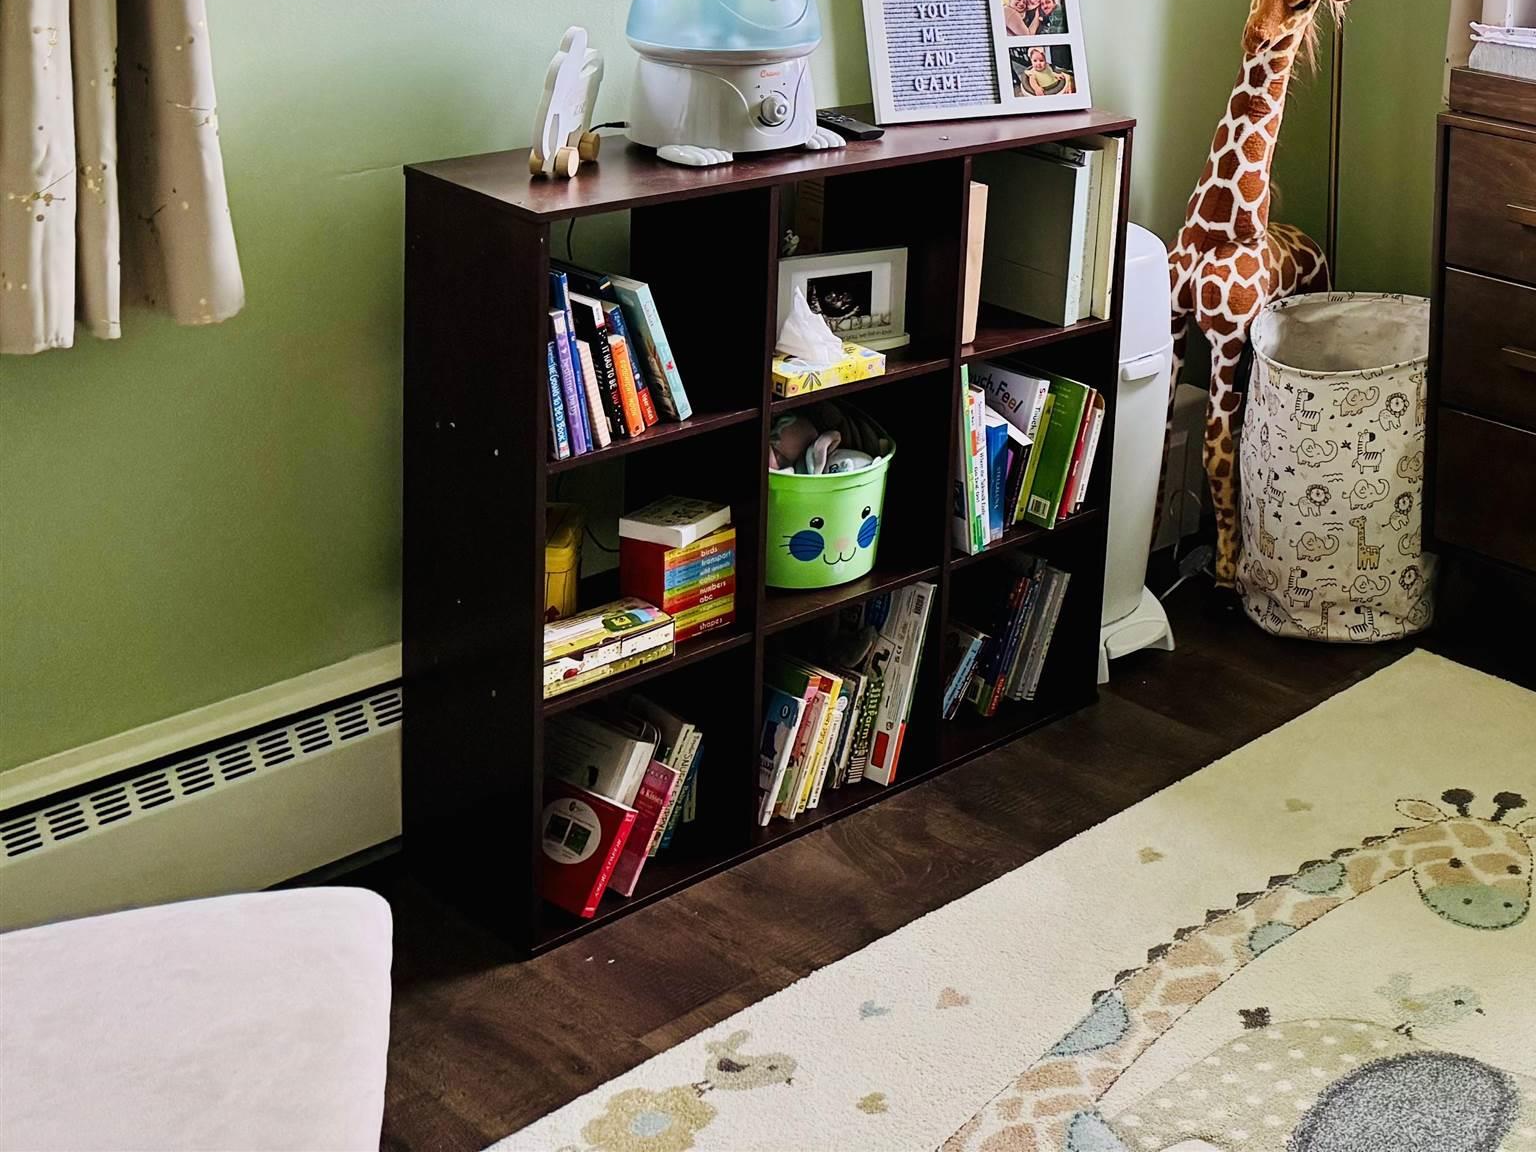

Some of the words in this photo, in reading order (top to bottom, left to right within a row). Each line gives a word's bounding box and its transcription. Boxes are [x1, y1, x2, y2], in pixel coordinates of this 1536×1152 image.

[914, 2, 949, 19] YOU
[921, 27, 945, 43] ME
[924, 51, 955, 67] AND
[914, 74, 961, 91] CAMI
[609, 378, 617, 389] BE
[996, 381, 1023, 413] Feel
[701, 546, 718, 557] birds
[700, 594, 713, 603] abc
